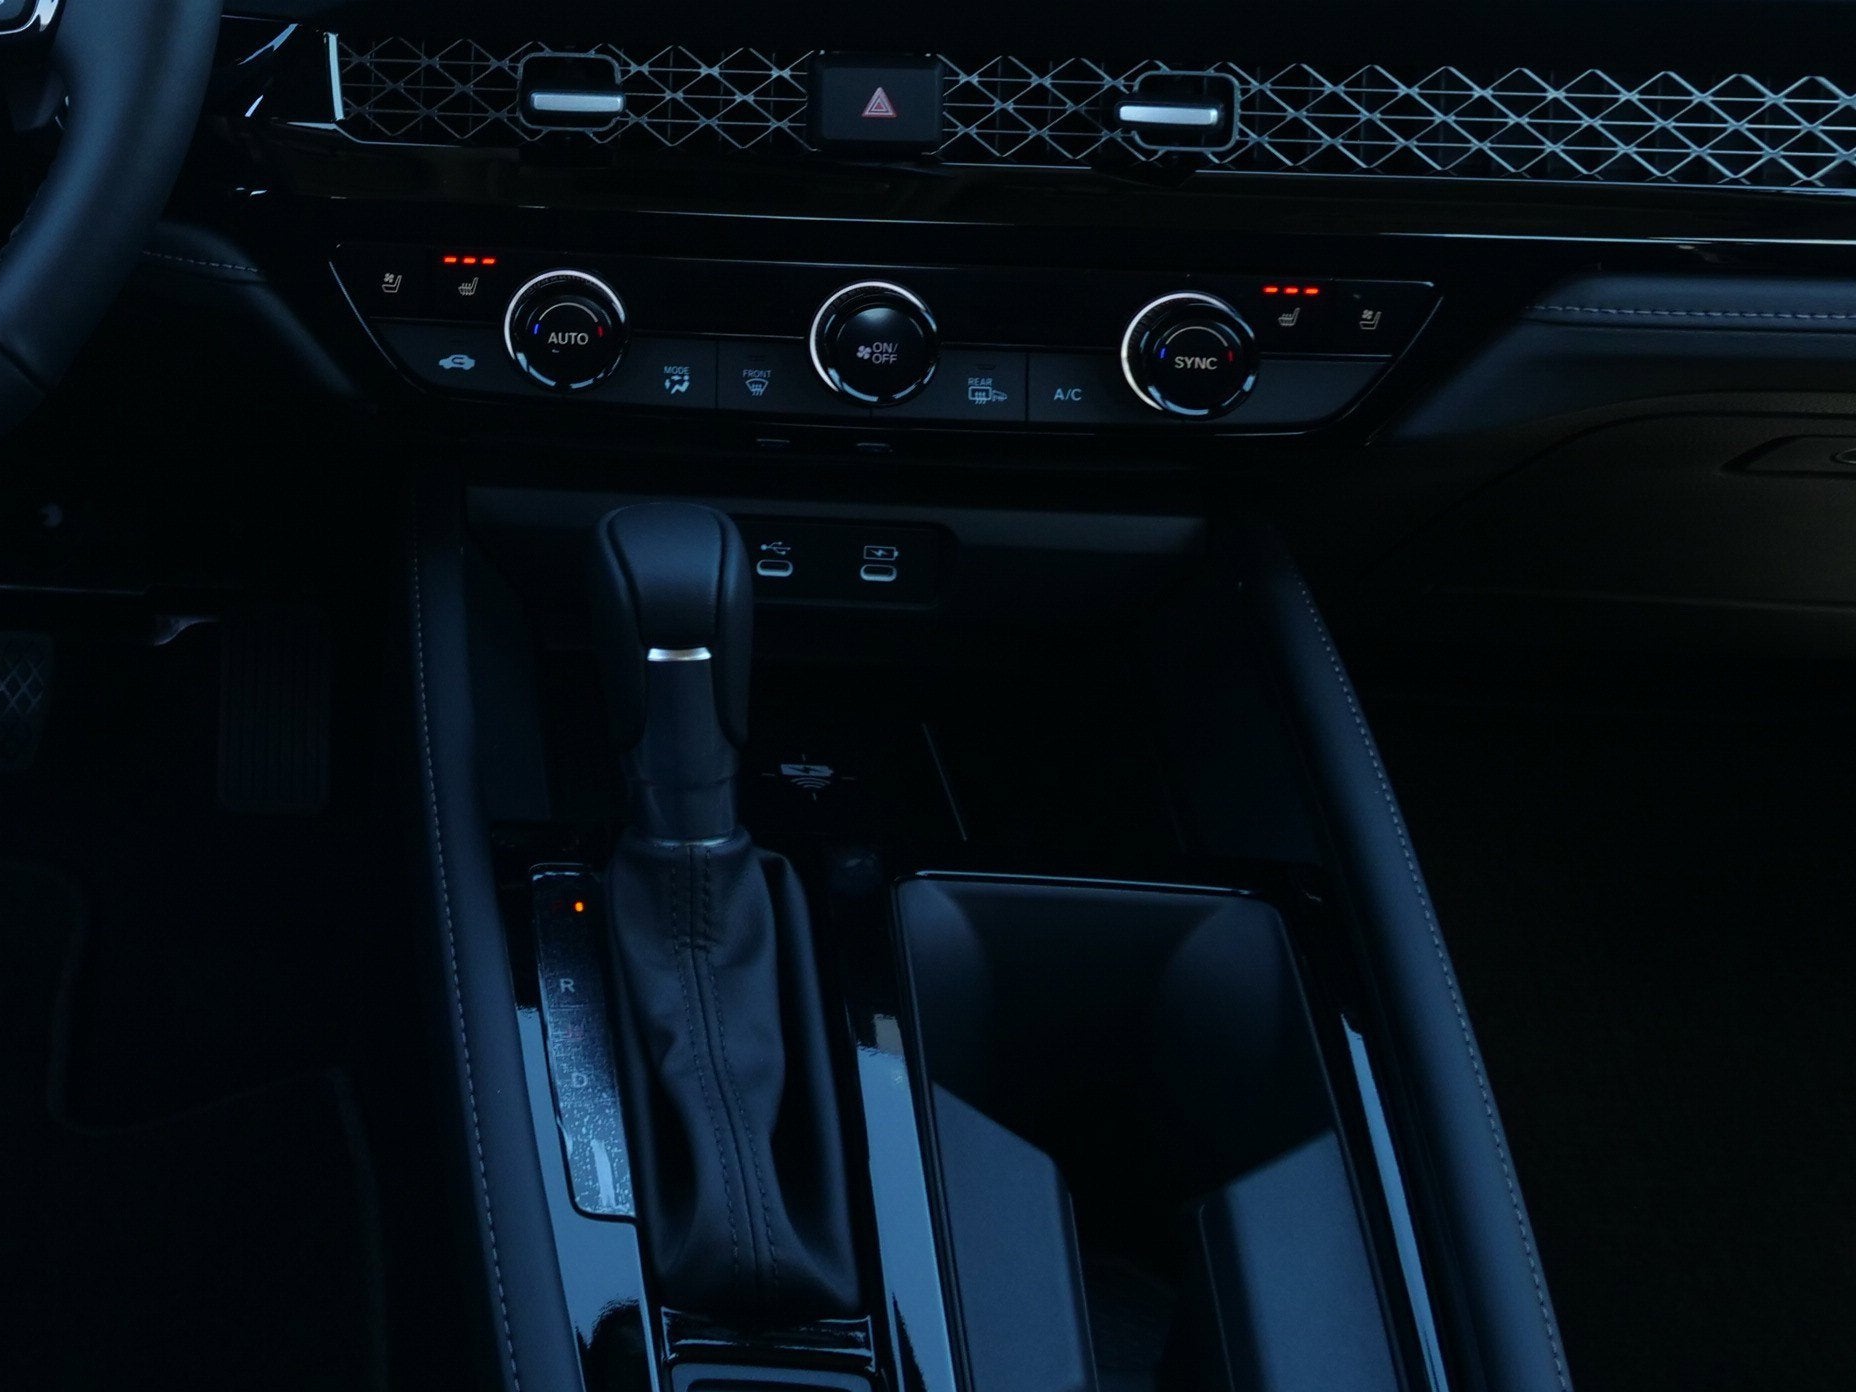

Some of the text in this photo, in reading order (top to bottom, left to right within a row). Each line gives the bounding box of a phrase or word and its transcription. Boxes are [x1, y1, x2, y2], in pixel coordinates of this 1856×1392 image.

[546, 331, 590, 346] AUTO
[871, 341, 899, 354] ON/
[871, 353, 898, 365] OFF
[1174, 356, 1218, 371] SYNC
[663, 366, 691, 374] MODE
[742, 369, 772, 378] FRONT
[967, 377, 993, 386] REAR
[1053, 388, 1083, 402] A/C
[559, 977, 575, 994] R
[571, 1072, 589, 1089] D
